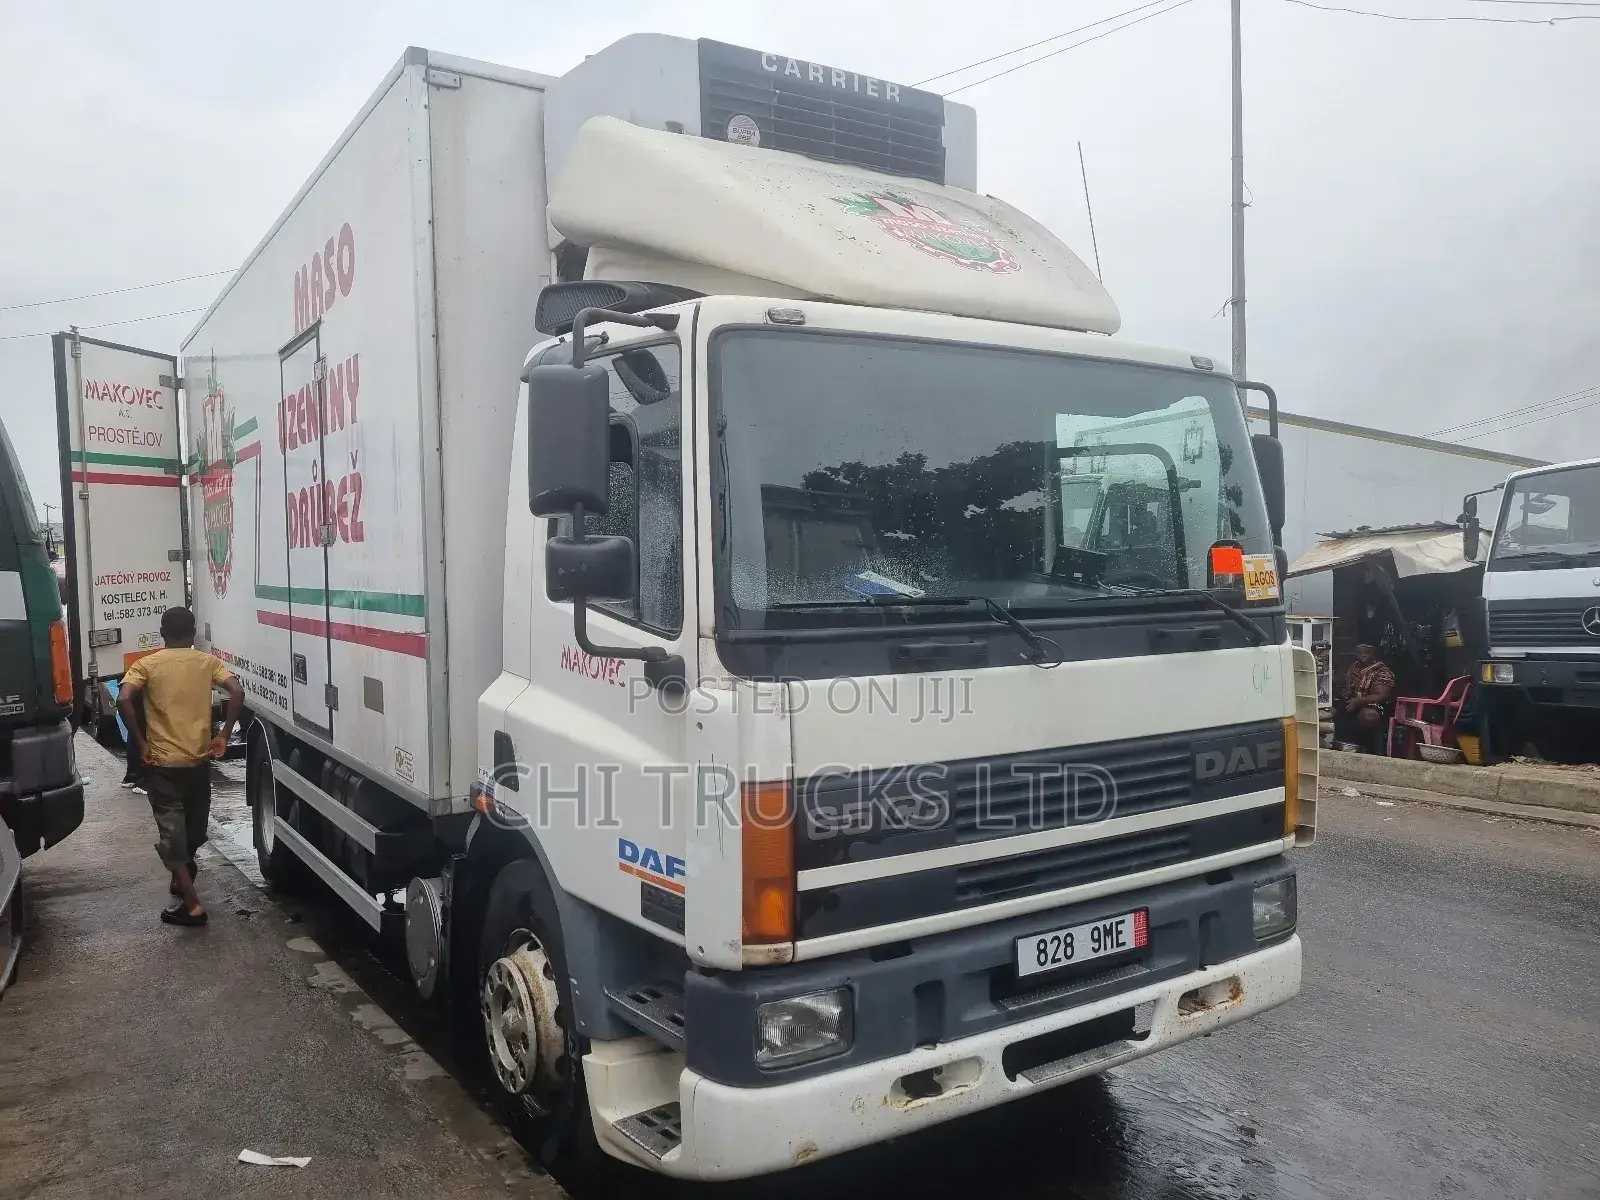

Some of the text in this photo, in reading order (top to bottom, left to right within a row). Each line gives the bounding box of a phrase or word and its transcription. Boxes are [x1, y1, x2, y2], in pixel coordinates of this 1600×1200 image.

[761, 52, 900, 103] CARRIER
[732, 127, 756, 137] SUPRA
[294, 221, 355, 335] MASO
[85, 378, 164, 410] MAKOVEC
[277, 352, 360, 456] UZENINY
[88, 425, 163, 447] PROSTĚJOV
[288, 449, 365, 550] DRŮBEŽ
[95, 571, 171, 587] JATEČNÝ PROVOZ
[101, 589, 168, 605] KOSTELEC N. H.
[1248, 571, 1275, 587] LAGOS
[103, 605, 167, 621] tel.:582 373 403
[560, 644, 626, 688] MAKOVEC
[1195, 740, 1285, 780] DAF
[618, 837, 686, 879] DAF
[1036, 932, 1075, 967] 828
[1090, 919, 1127, 954] 9ME
